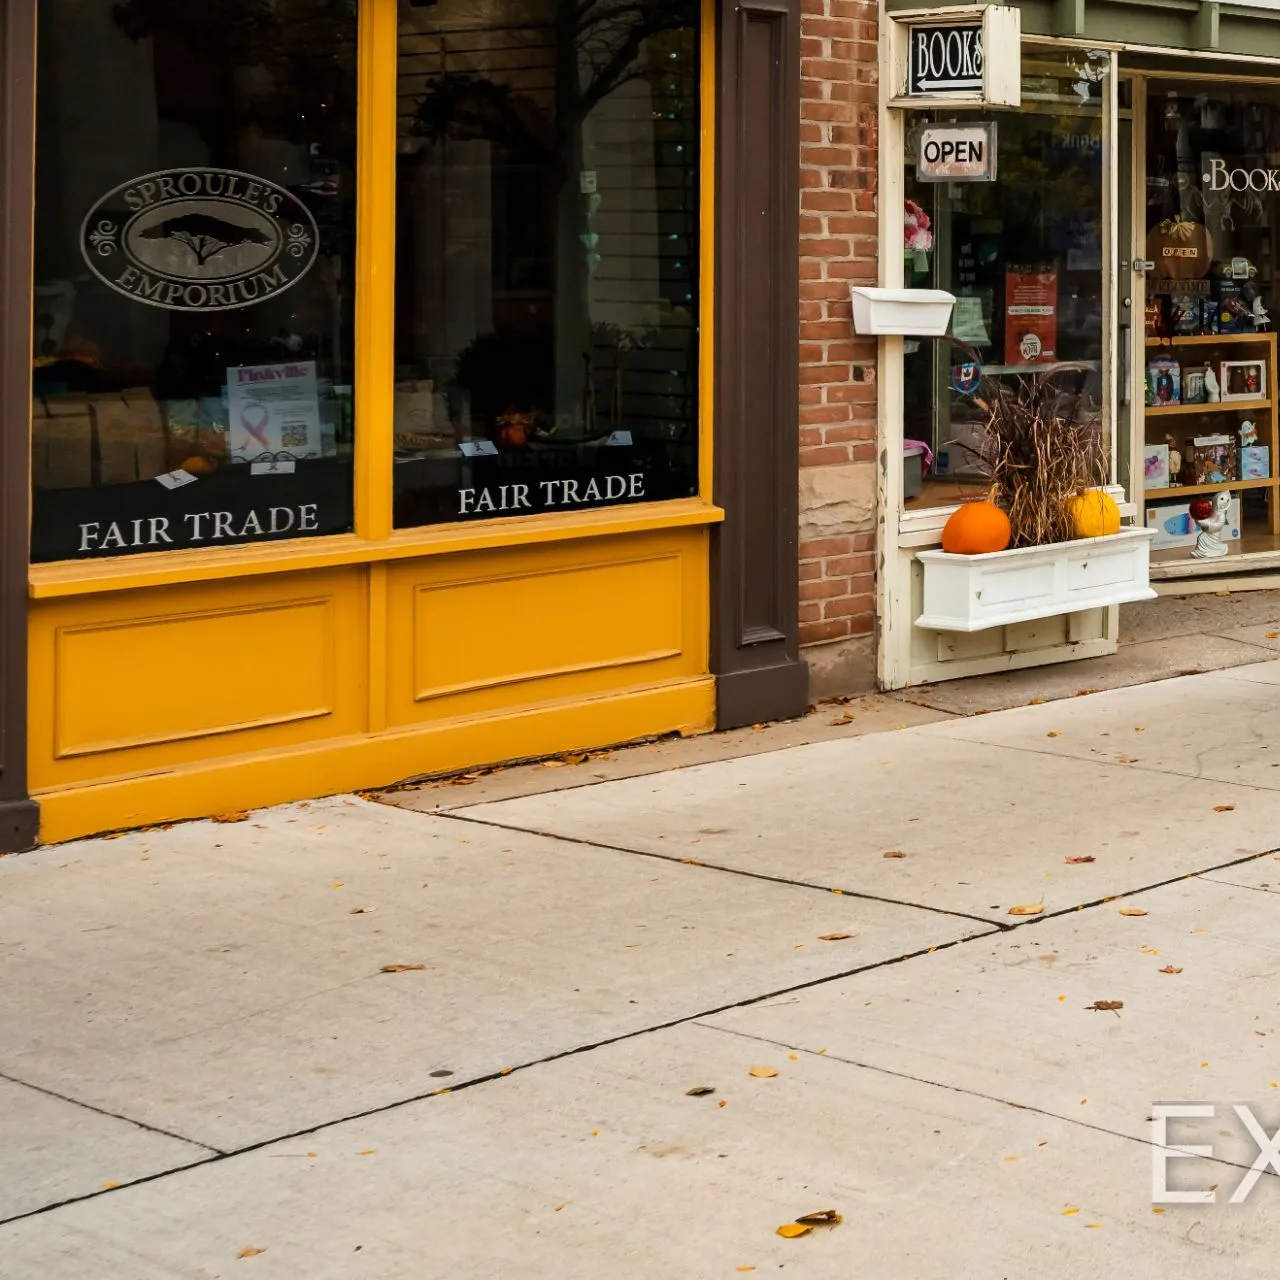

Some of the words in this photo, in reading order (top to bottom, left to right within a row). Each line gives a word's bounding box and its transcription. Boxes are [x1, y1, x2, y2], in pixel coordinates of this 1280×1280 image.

[917, 29, 983, 78] BOOKS
[924, 140, 983, 164] OPEN
[124, 173, 283, 214] SPROULE'S
[1163, 248, 1196, 256] OPEN
[115, 264, 289, 307] EMPORIUM
[457, 482, 531, 514] FAIR
[539, 473, 645, 504] TRADE
[78, 515, 173, 552] FAIR
[184, 503, 318, 537] TRADE
